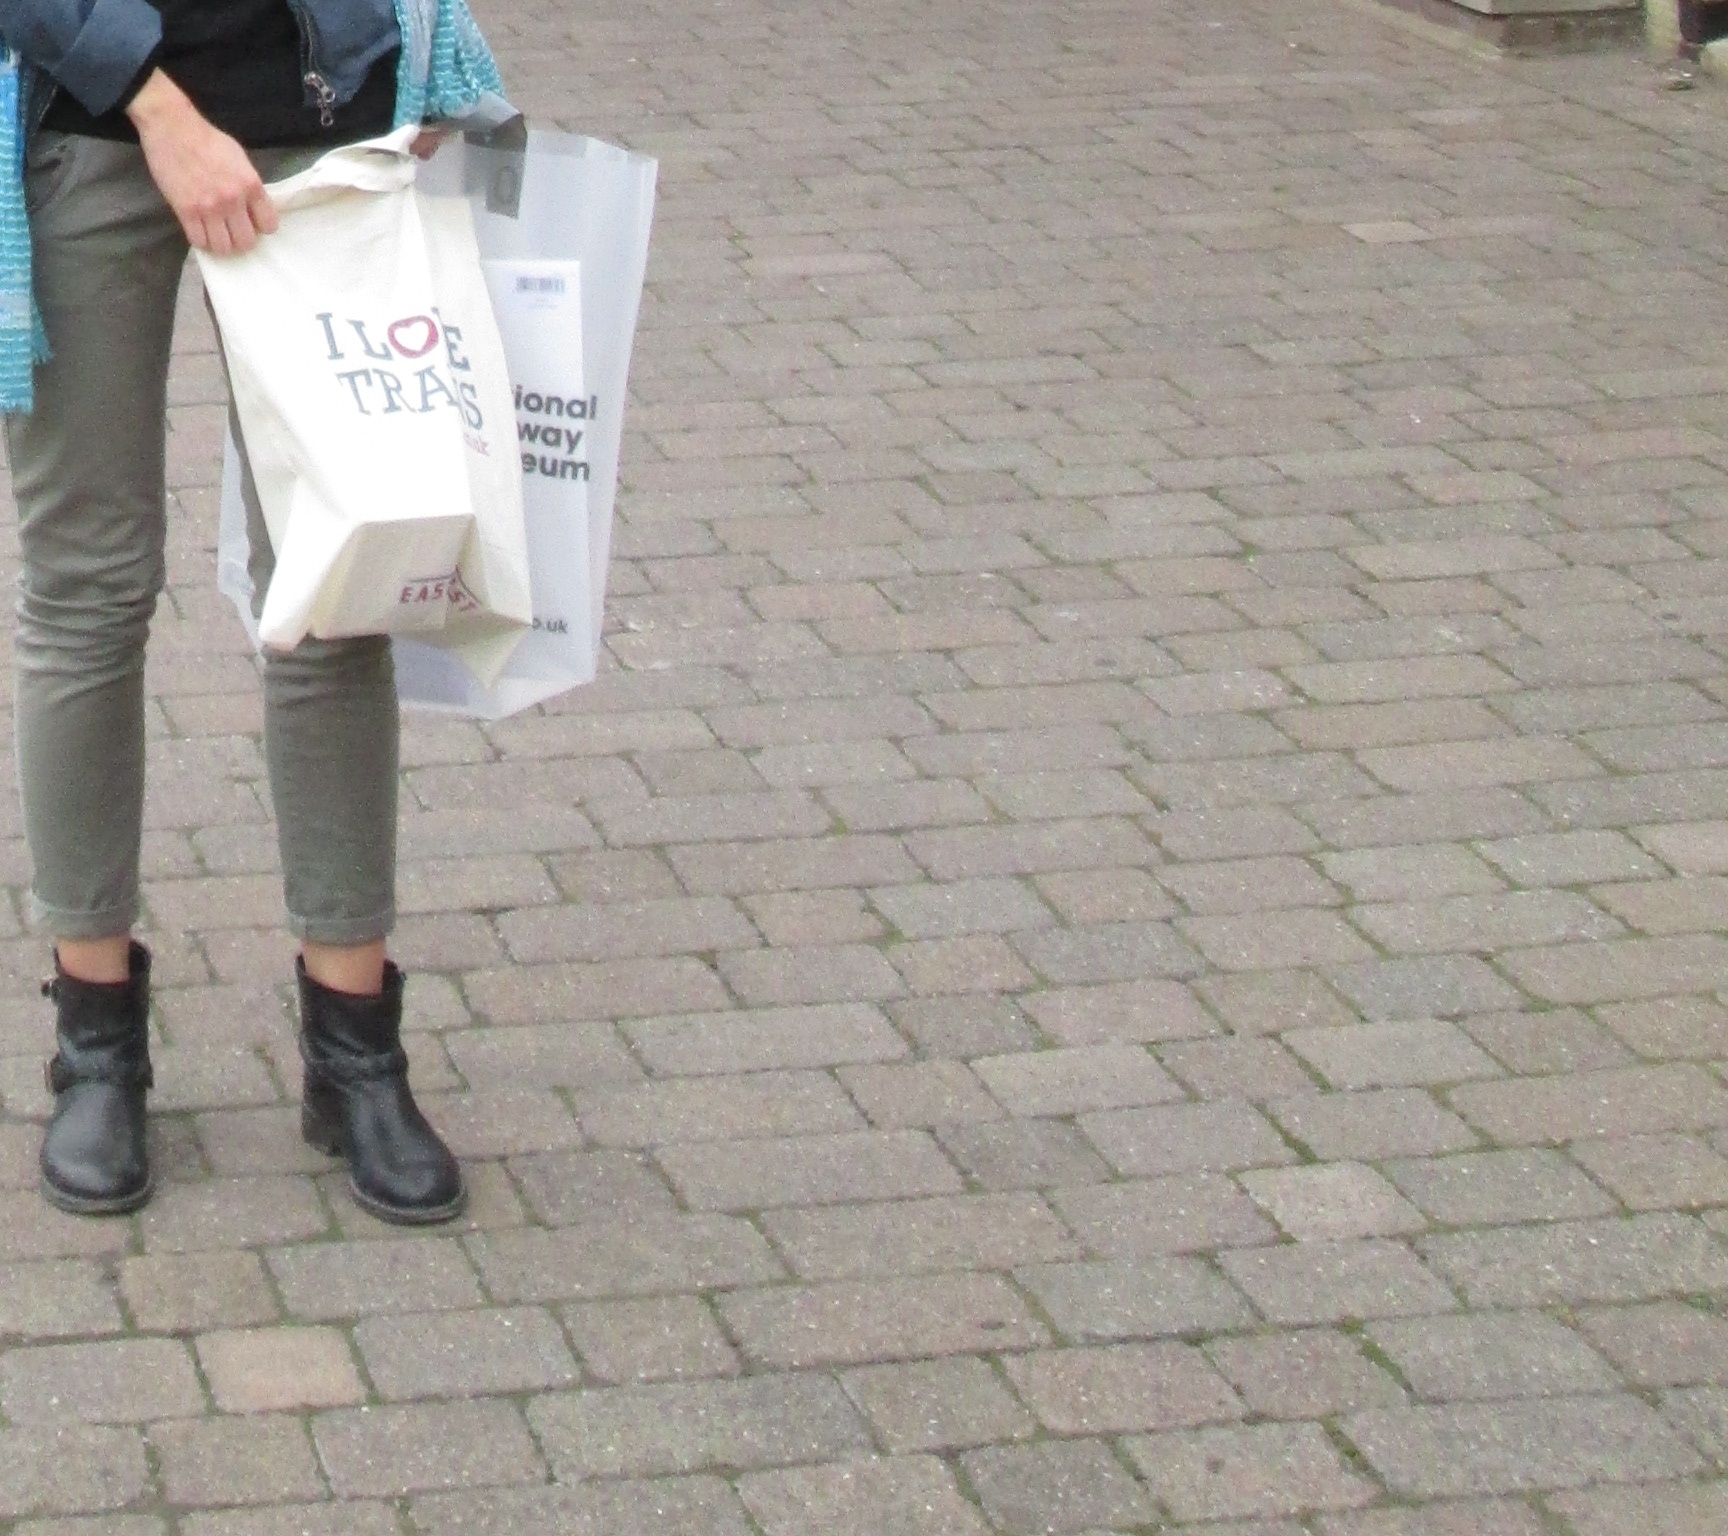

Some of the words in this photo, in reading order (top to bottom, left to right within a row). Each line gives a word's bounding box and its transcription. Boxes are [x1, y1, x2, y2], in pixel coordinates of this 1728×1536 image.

[315, 312, 344, 360] I
[513, 384, 598, 421] ional
[520, 450, 592, 481] eum
